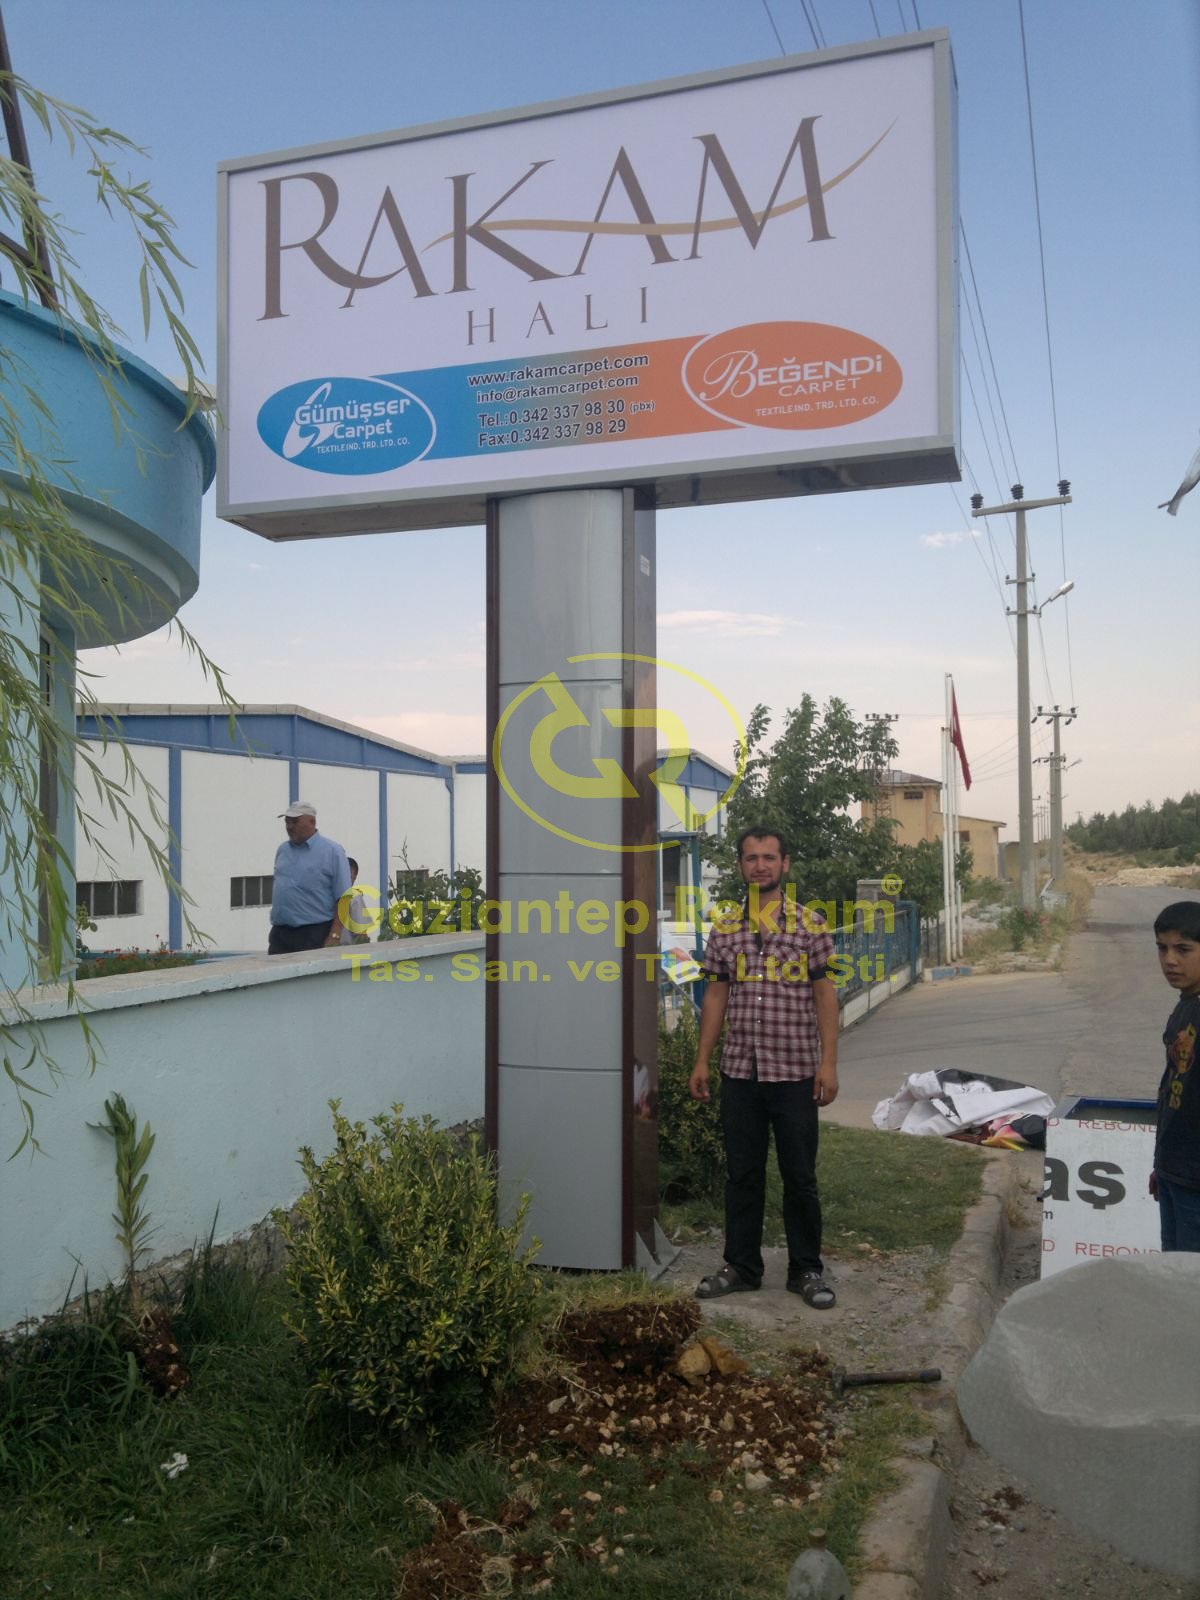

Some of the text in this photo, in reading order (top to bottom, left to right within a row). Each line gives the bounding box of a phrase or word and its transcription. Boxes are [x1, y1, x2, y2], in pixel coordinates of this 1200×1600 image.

[256, 115, 837, 322] RAKAM
[466, 286, 649, 345] HALI
[468, 354, 649, 387] www.rakamcarpet.com
[476, 374, 639, 404] info@rakamcarpet.com
[778, 377, 861, 398] CARPET
[553, 404, 580, 420] 337
[584, 401, 602, 417] 98
[607, 399, 625, 414] 30
[629, 400, 656, 415] (pbx)
[756, 395, 880, 417] TEXTILE IND. TRD. LTD. CO.
[333, 419, 393, 440] Carpet
[554, 423, 581, 439] 337
[585, 421, 603, 436] 98
[608, 418, 627, 434] 29
[316, 444, 345, 454] TEXTILE
[362, 441, 379, 449] TRD.
[380, 439, 396, 448] LTD.
[397, 437, 411, 446] CO.
